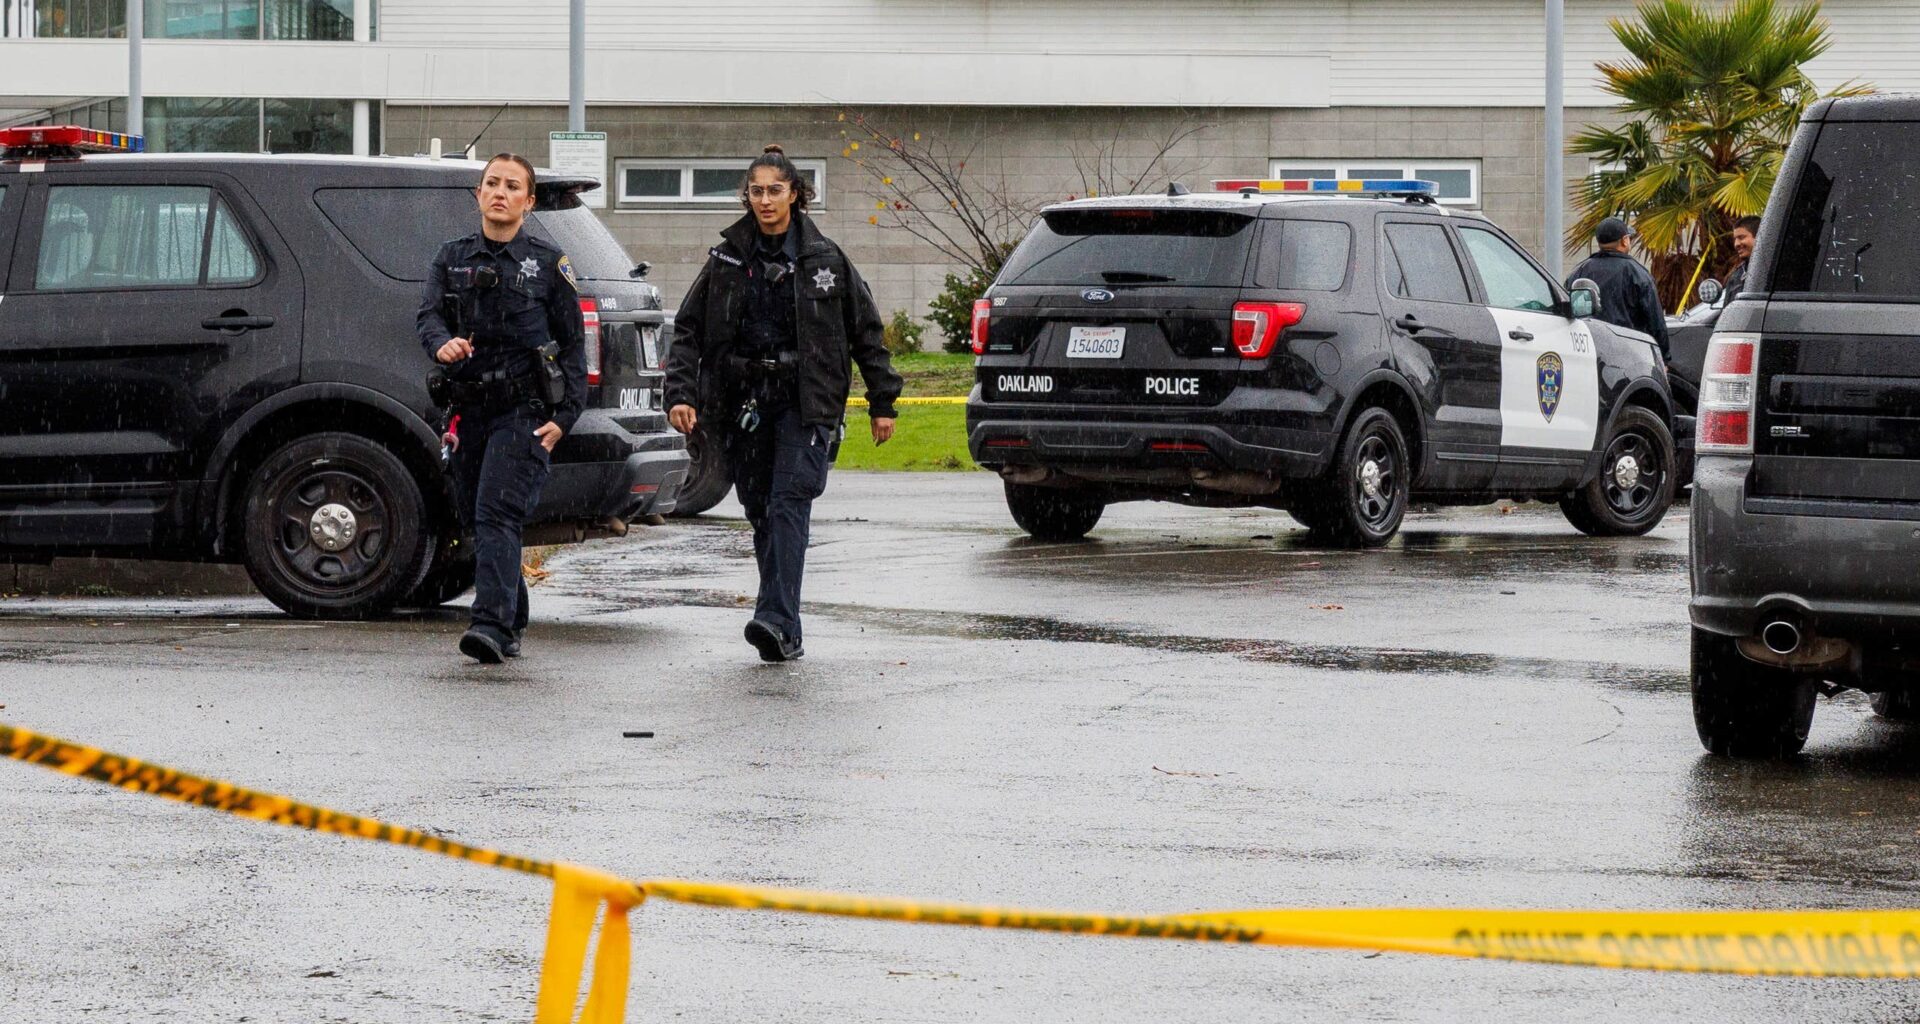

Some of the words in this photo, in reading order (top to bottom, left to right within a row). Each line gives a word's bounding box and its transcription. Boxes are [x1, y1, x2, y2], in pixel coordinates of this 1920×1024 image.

[600, 298, 617, 309] 1489
[1087, 291, 1108, 301] Ford
[1071, 339, 1120, 353] 1540603
[1569, 331, 1590, 353] 1887
[998, 374, 1054, 393] OAKLAND
[1145, 377, 1200, 395] POLICE
[620, 388, 651, 410] OAKLAND
[1770, 425, 1810, 437] SEL
